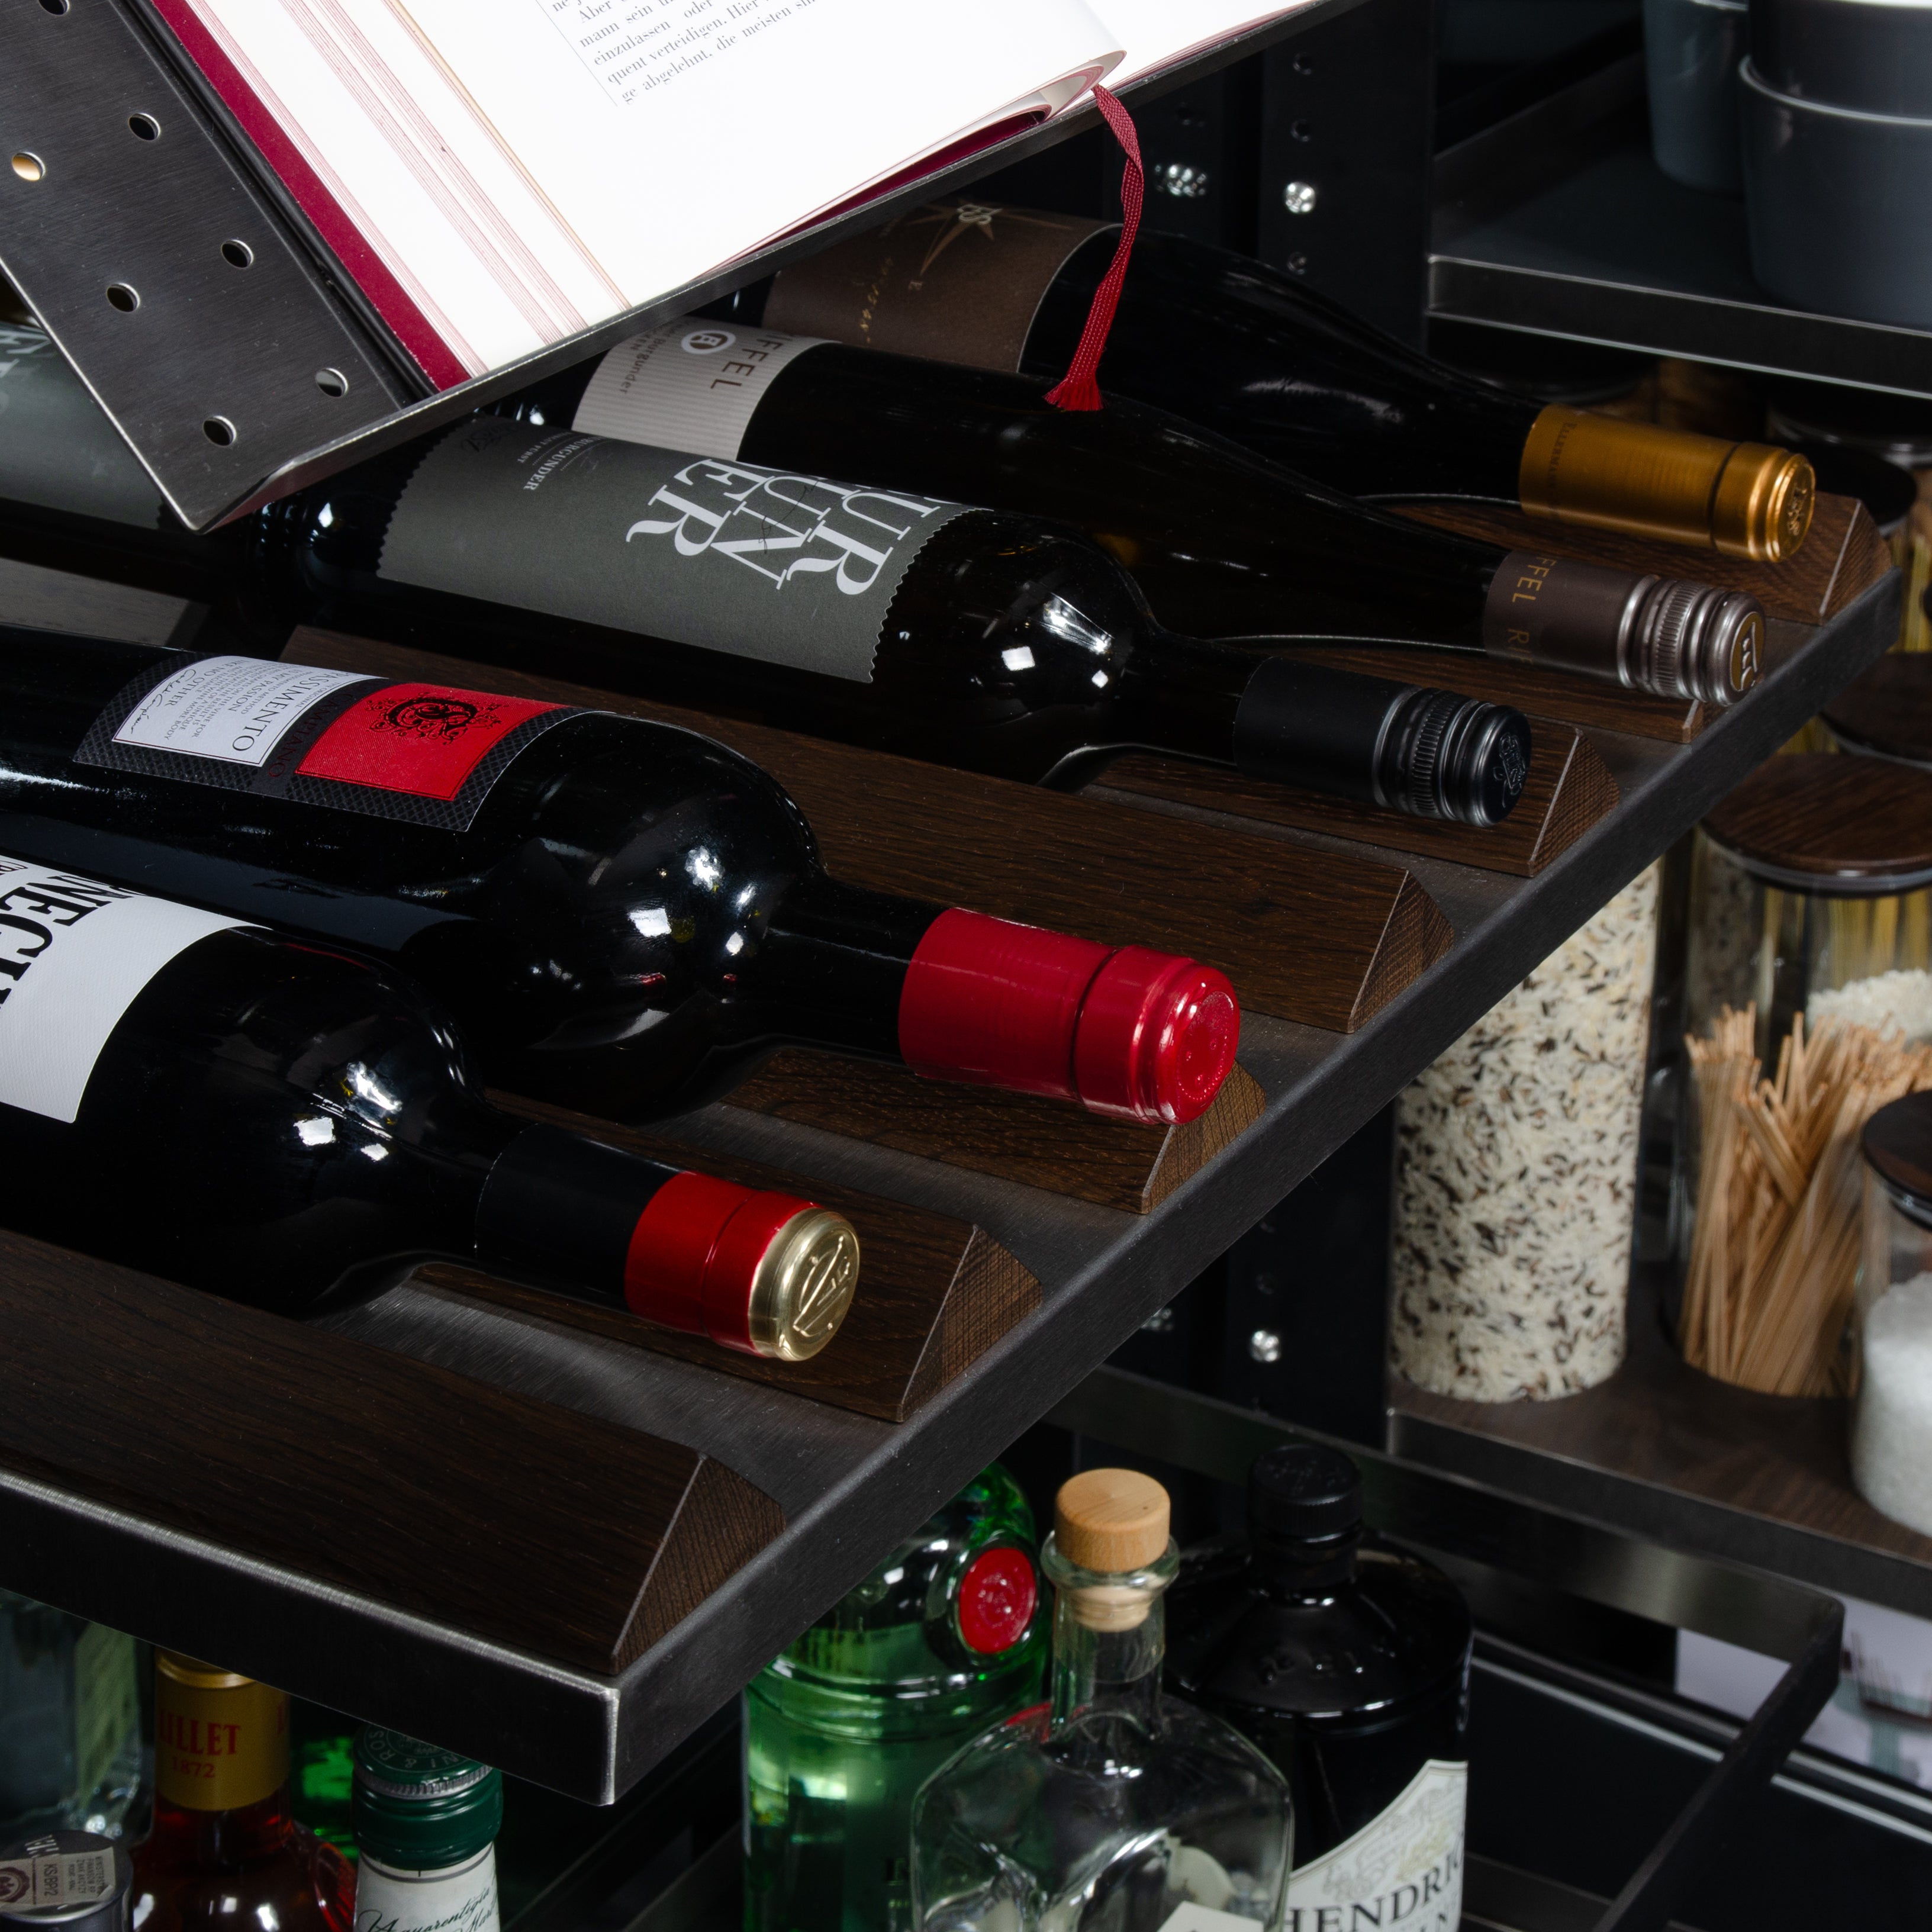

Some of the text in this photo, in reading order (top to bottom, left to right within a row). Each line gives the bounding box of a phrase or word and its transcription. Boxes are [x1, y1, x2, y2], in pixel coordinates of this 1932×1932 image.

[578, 0, 612, 24] Aber
[579, 5, 653, 47] mann sein
[594, 0, 713, 65] einzulassen oder
[608, 0, 758, 85] quent verteidigen. Hier
[622, 88, 638, 105] ge
[716, 36, 739, 51] die
[742, 7, 792, 37] meisten
[711, 333, 794, 389] IFFEL
[523, 436, 604, 490] BURGUNDER
[626, 459, 775, 556] ER
[710, 475, 861, 590] UN
[786, 491, 942, 595] UR
[1512, 556, 1558, 603] FFEL
[202, 666, 226, 676] NO
[165, 678, 204, 706] OTHER
[196, 687, 215, 700] WINE
[217, 695, 234, 706] THE
[226, 680, 274, 711] PASSION
[231, 687, 243, 695] ON
[241, 692, 269, 714] METHOD
[179, 701, 198, 719] MORE
[179, 705, 204, 730] UNIQUE
[198, 697, 221, 717] RESULT
[204, 707, 221, 723] VINE
[233, 672, 349, 751] PASSIMENTO
[164, 720, 181, 740] BODY
[192, 724, 206, 738] FOR
[173, 1756, 215, 1778] 1872
